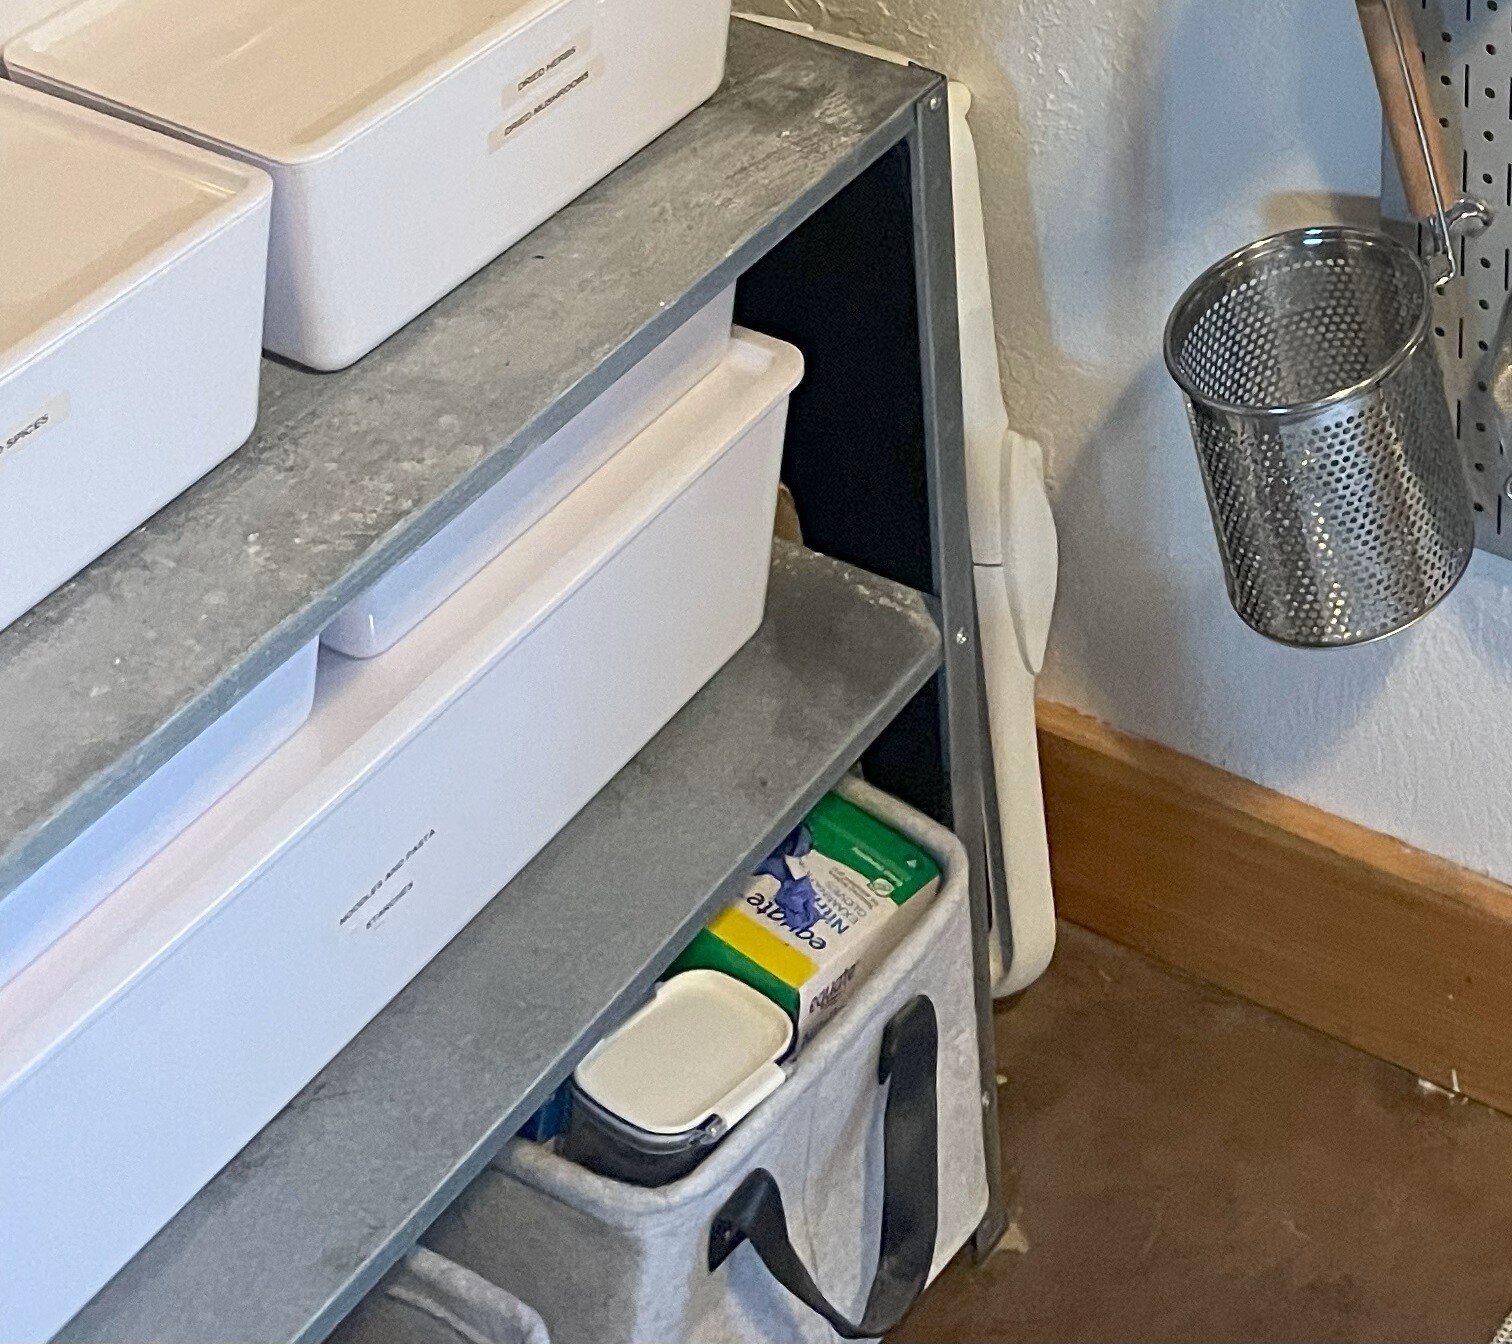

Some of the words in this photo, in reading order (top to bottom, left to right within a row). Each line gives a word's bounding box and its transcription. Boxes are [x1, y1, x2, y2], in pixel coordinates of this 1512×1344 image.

[517, 67, 545, 92] DRIED
[504, 111, 533, 137] DRIED
[6, 413, 49, 449] SPICES
